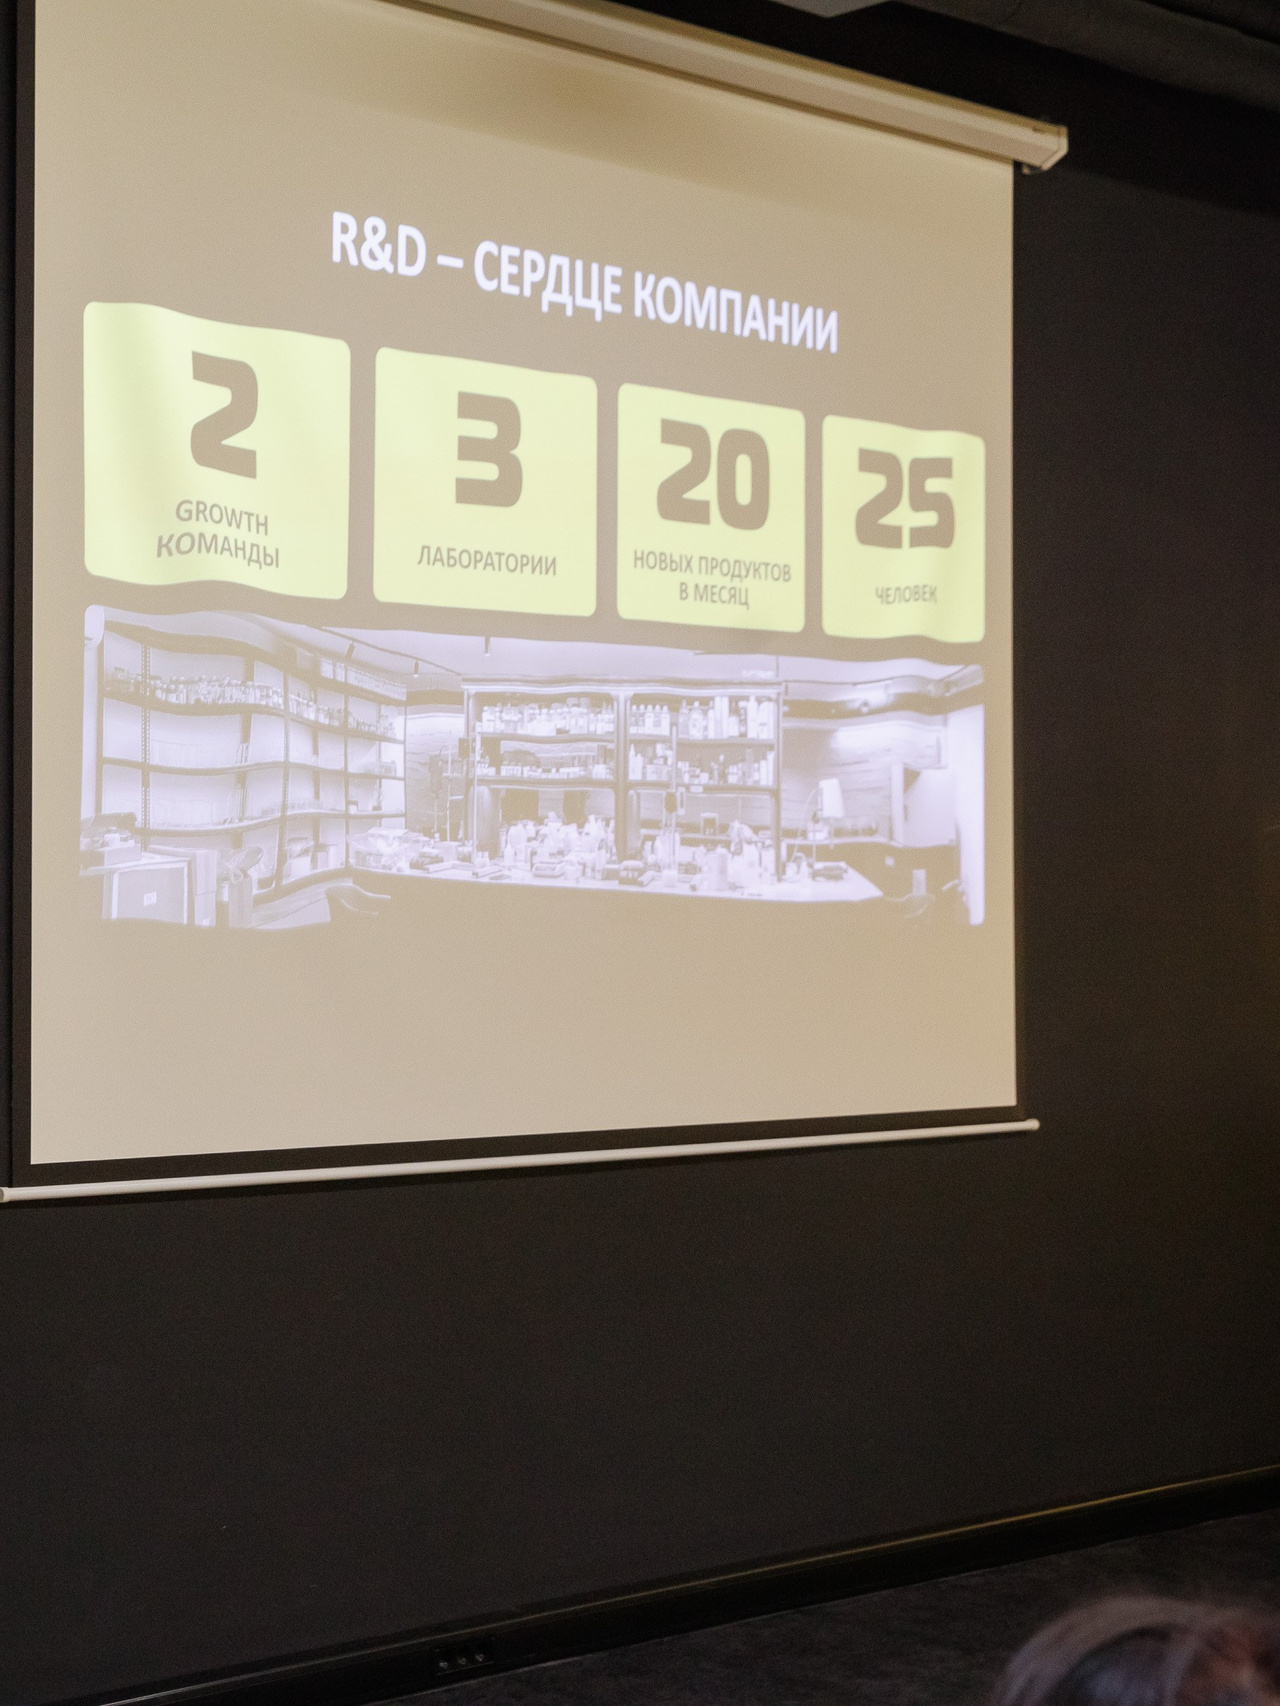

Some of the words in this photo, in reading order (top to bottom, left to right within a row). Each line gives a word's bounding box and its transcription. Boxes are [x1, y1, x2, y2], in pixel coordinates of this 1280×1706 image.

[331, 210, 427, 276] R&D
[474, 240, 622, 322] СЕРДЦЕ
[634, 271, 838, 353] КОМПАНИИ
[189, 349, 258, 479] 2
[455, 391, 523, 507] 3
[656, 418, 770, 531] 20
[855, 447, 956, 549] 25
[175, 499, 268, 536] GROWTH
[156, 532, 279, 570] КОМАНДЫ
[417, 545, 556, 576] ЛАБОРАТОРИИ
[633, 549, 694, 574] НОВЫХ
[698, 555, 792, 583] ПРОДУКТОВ
[679, 582, 689, 601] В
[693, 584, 750, 609] МЕСЯЦ
[874, 585, 938, 605] ЧЕЛОВЕК
